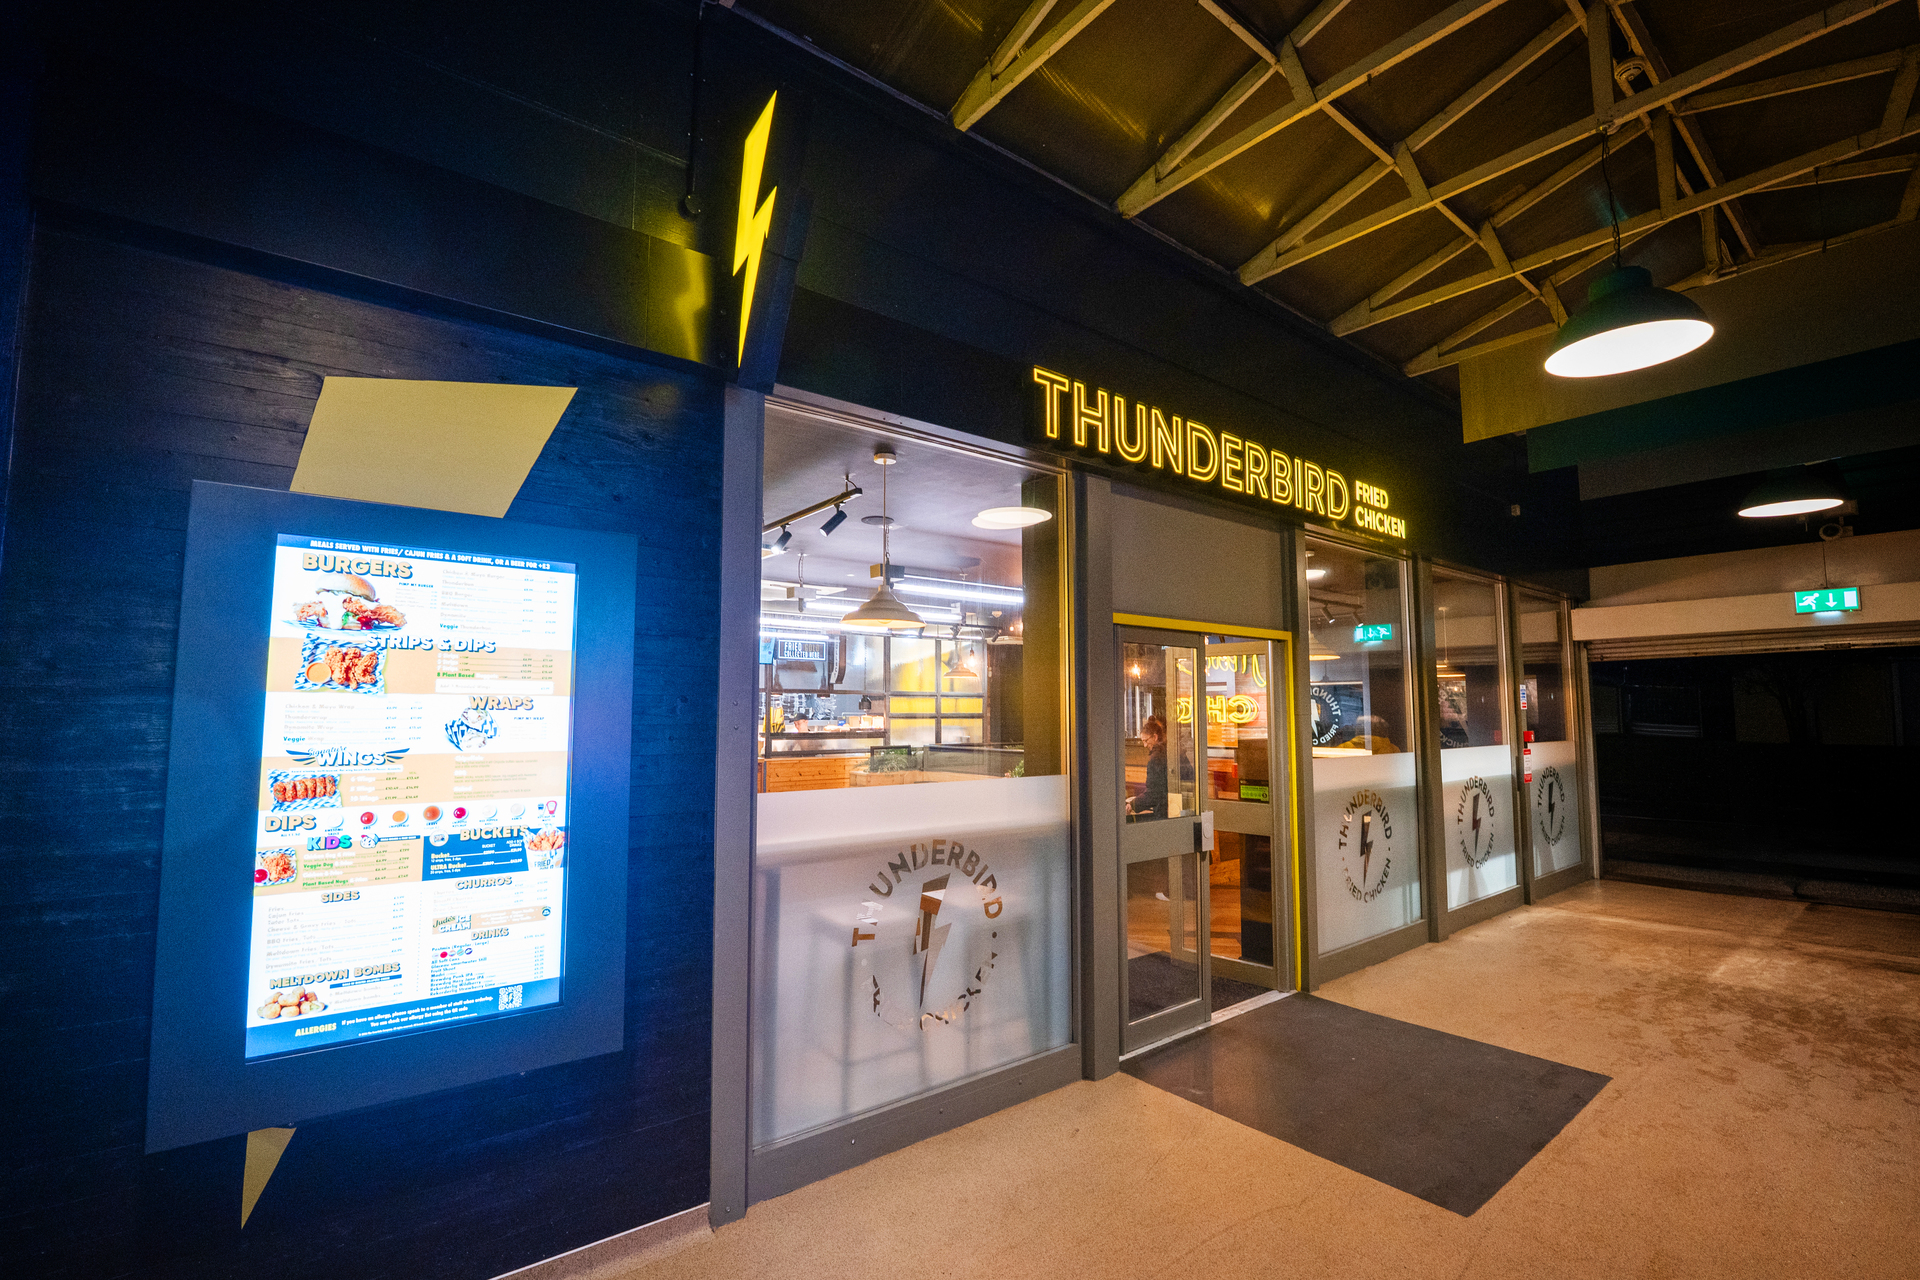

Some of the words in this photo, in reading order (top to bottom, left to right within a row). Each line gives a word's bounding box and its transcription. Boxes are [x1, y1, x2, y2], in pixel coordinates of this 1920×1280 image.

[1033, 365, 1349, 521] THUNDERBIRD
[1355, 480, 1388, 510] FRIED
[1354, 506, 1406, 539] CHICKEN
[310, 540, 333, 549] MEALS
[335, 542, 360, 552] SERVED
[362, 545, 379, 553] WITH
[404, 550, 425, 558] CAJUN
[426, 552, 443, 560] FRIES
[302, 552, 412, 580] BURGERS
[365, 634, 434, 651] STRIPS
[437, 636, 451, 651] &
[453, 638, 496, 653] DIPS
[468, 696, 534, 711] WRAPS
[315, 751, 387, 767] WINGS
[1538, 766, 1564, 808] THUNDERBIRD
[1458, 775, 1494, 825] THUNDERBIRD
[265, 814, 317, 833] DIPS
[460, 825, 529, 840] BUCKETS
[307, 835, 353, 851] KIDS
[1460, 839, 1475, 868] FRIED
[1475, 832, 1494, 869] CHICKEN
[455, 876, 512, 890] CHURROS
[1364, 858, 1391, 903] CHICKEN
[320, 890, 360, 903] SIDES
[438, 923, 471, 933] CREAM
[455, 914, 471, 923] ICE
[471, 928, 509, 940] DRINKS
[269, 969, 350, 990] MELTDOWN
[354, 962, 400, 977] BOMBS
[295, 1023, 337, 1037] ALLERGIES
